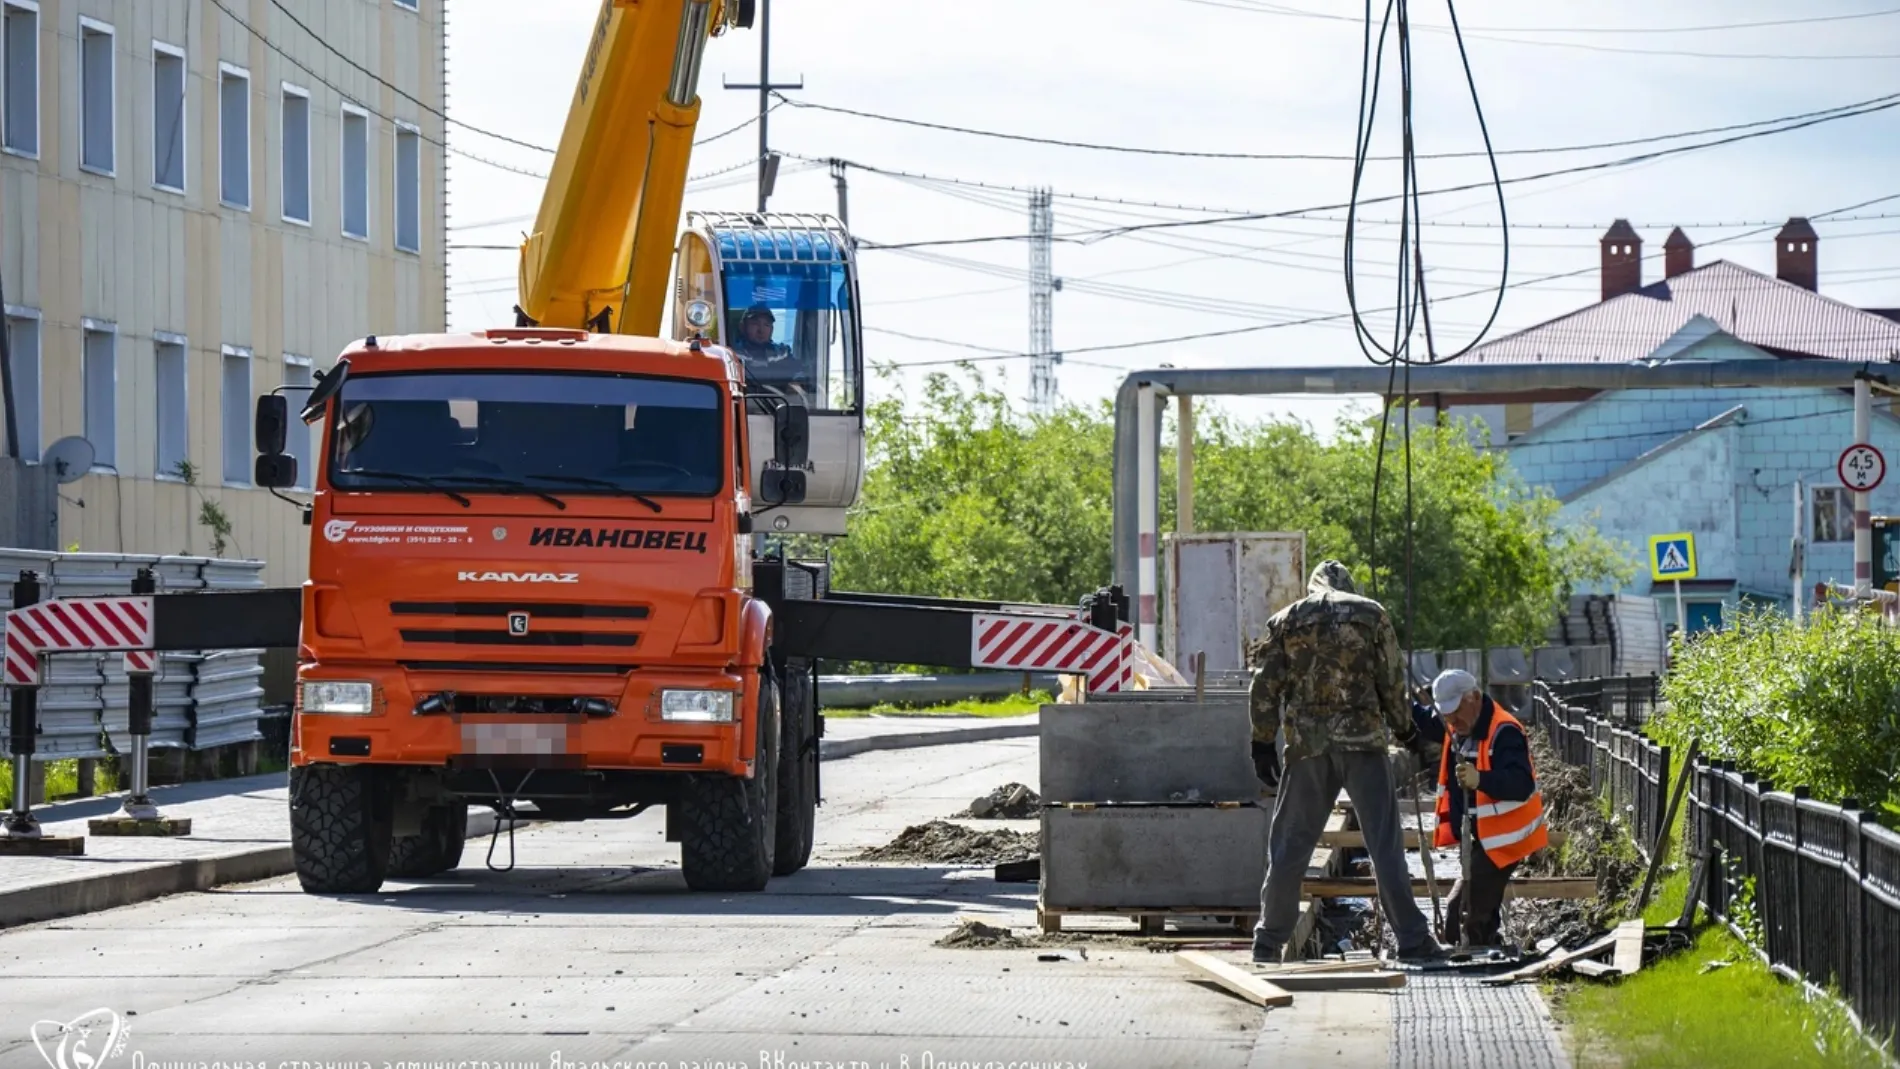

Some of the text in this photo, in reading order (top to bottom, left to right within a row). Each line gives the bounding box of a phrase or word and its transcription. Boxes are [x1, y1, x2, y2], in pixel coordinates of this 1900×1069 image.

[353, 525, 404, 533] ГРУЗОВИКИ
[528, 527, 708, 554] ИВАНОВЕЦ
[457, 571, 579, 583] KAMAZ
